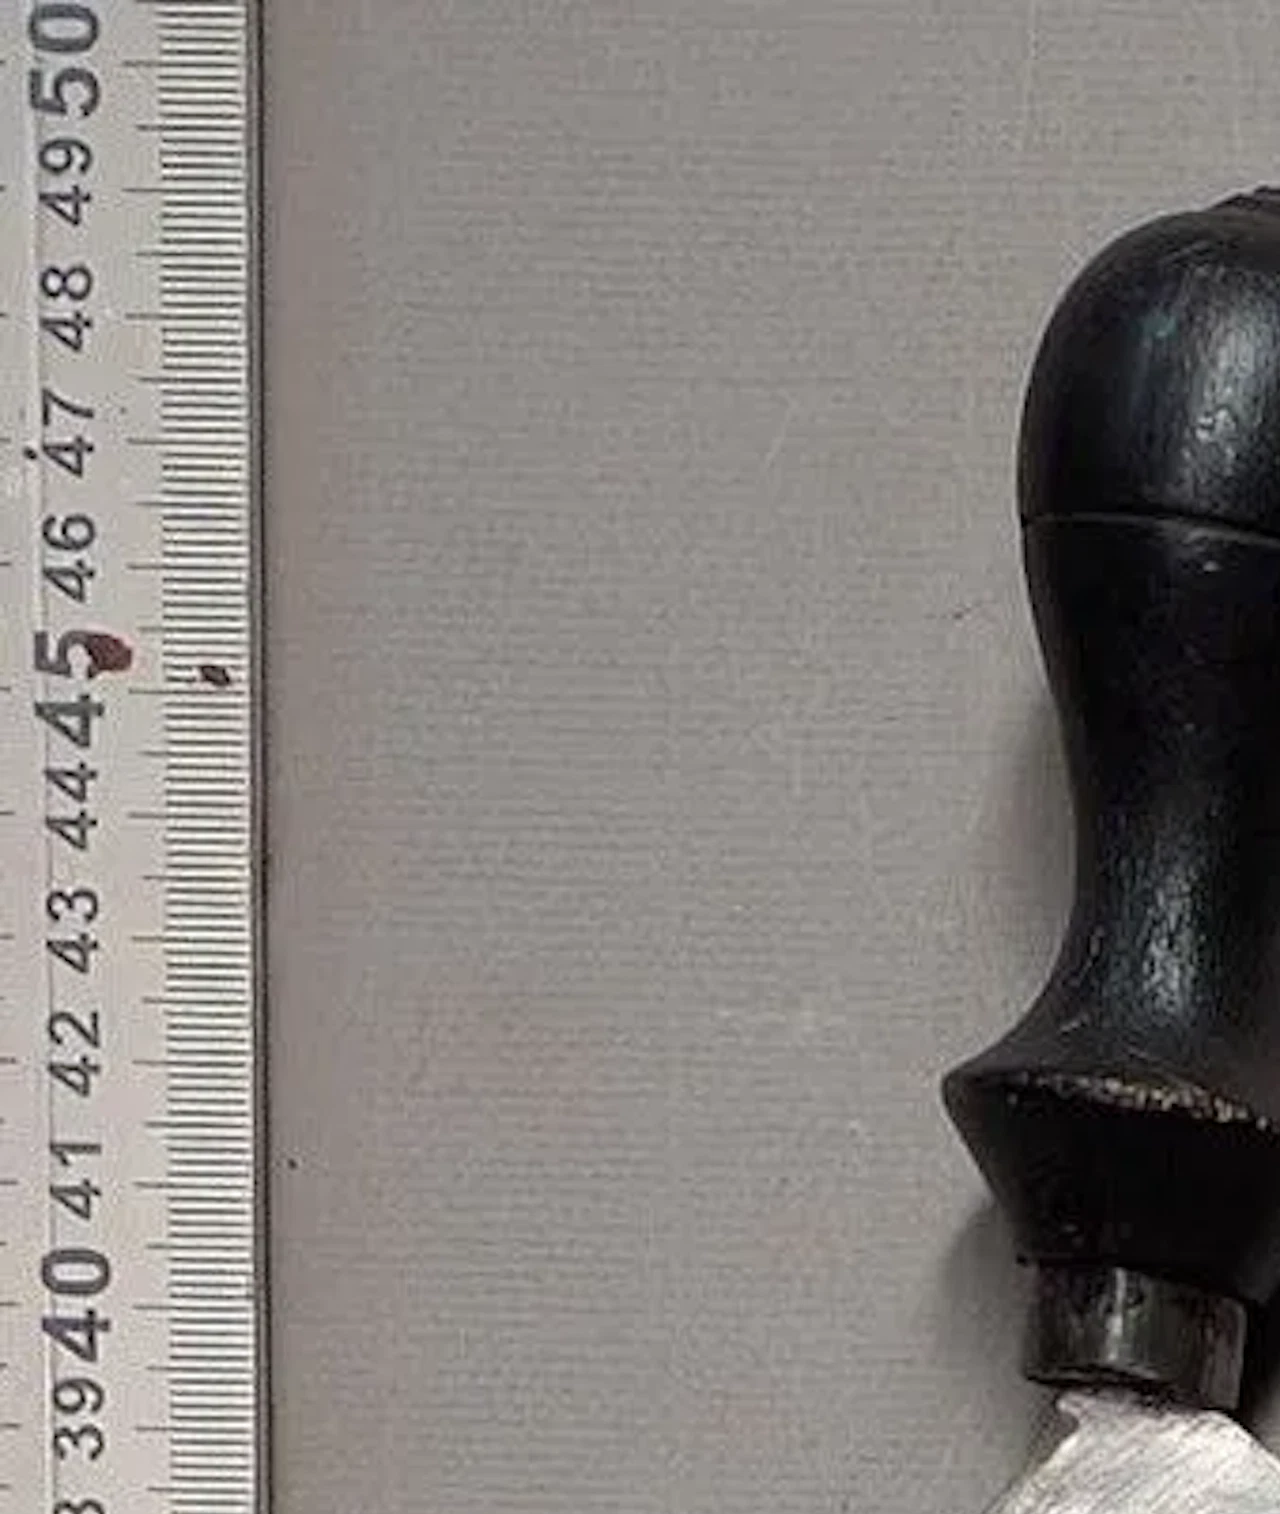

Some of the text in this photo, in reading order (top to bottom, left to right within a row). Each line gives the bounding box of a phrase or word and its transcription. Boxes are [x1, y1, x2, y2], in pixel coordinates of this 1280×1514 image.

[27, 3, 102, 119] 50
[37, 137, 94, 228] 49
[38, 263, 94, 354] 48
[40, 386, 96, 479] 47
[40, 513, 98, 604] 46
[33, 630, 100, 750] 45
[42, 760, 99, 852] 44
[44, 887, 101, 975] 43
[45, 987, 102, 1099] 42
[47, 1113, 103, 1222] 41
[39, 1247, 112, 1364] 40
[50, 1372, 106, 1462] 39
